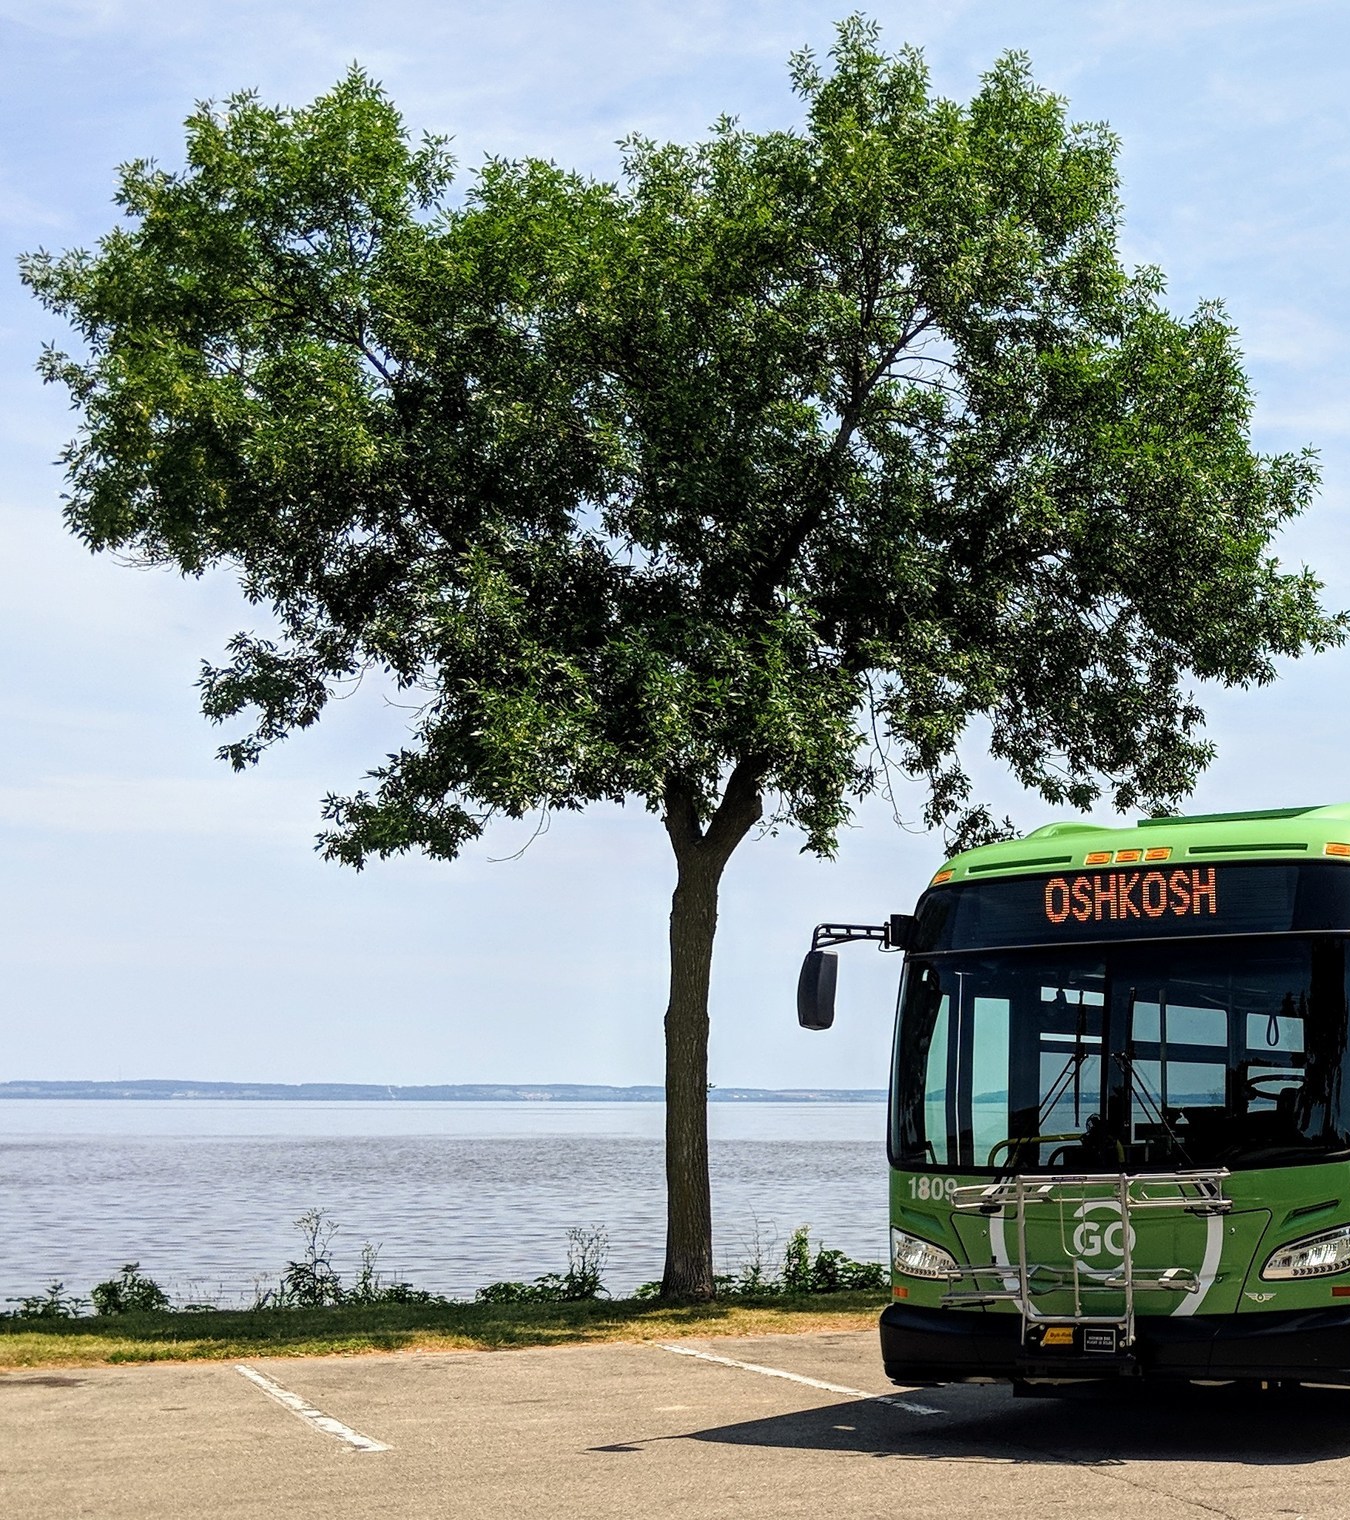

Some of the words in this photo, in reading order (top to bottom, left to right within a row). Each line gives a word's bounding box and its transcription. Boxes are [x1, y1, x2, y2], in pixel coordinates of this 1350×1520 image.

[1045, 868, 1216, 923] OSHKOSH
[908, 1176, 957, 1200] 1809
[1073, 1221, 1136, 1256] GO
